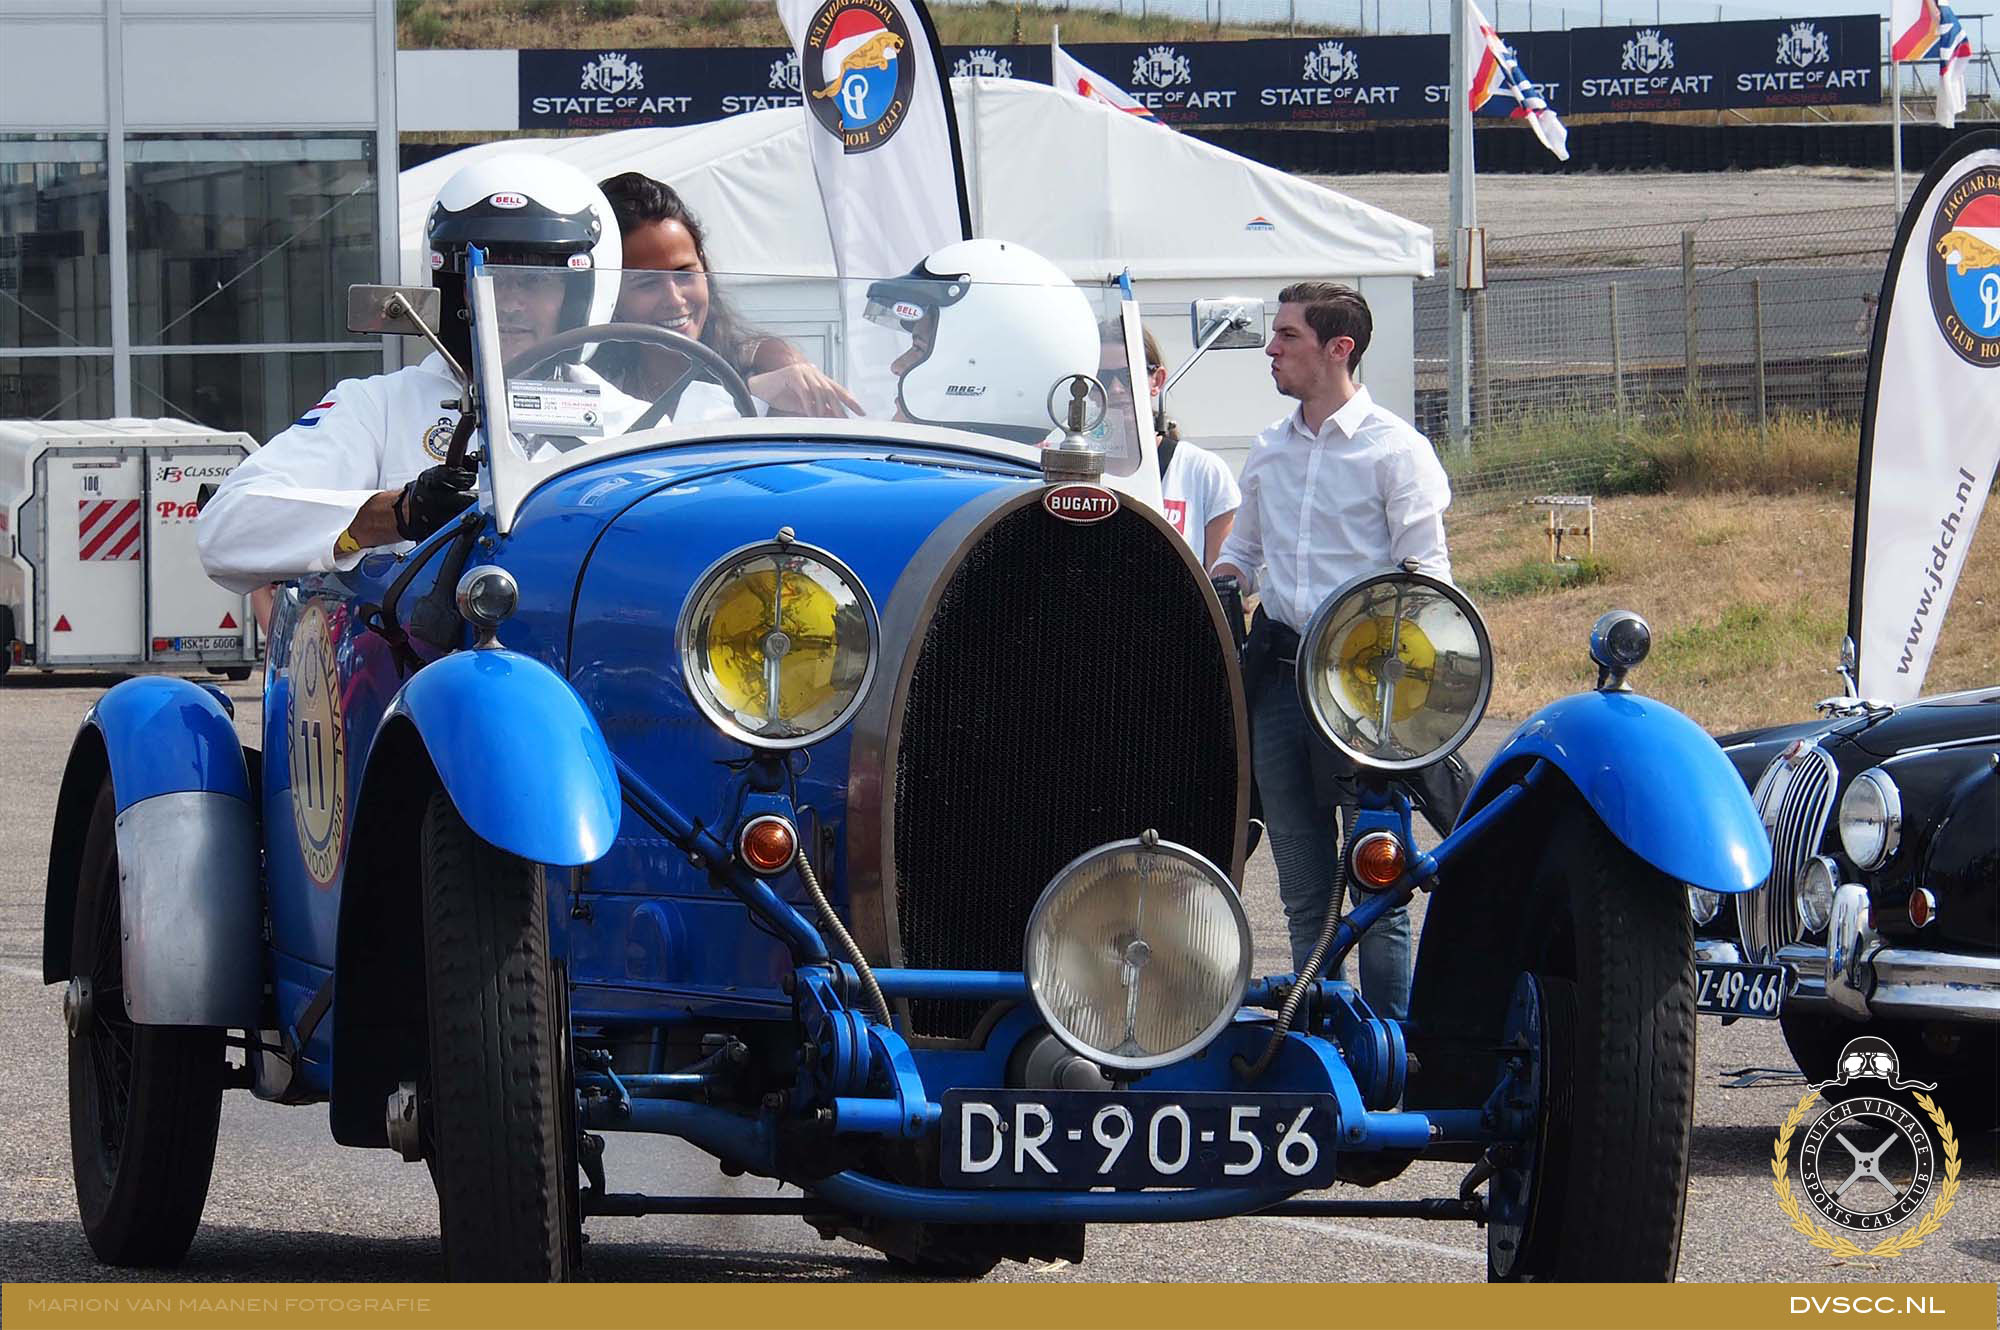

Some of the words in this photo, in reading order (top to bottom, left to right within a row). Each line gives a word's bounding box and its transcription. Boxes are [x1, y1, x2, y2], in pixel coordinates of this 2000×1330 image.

[1581, 78, 1649, 97] STATE
[1650, 77, 1669, 89] OF
[1669, 74, 1713, 94] ART
[1736, 72, 1805, 91] STATE
[1806, 71, 1825, 82] OF
[1825, 69, 1871, 88] ART
[532, 96, 614, 114] STATE
[615, 97, 638, 108] OF
[639, 96, 692, 114] ART
[721, 95, 802, 113] STATE
[1164, 91, 1185, 102] OF
[1186, 90, 1237, 108] ART
[1260, 88, 1332, 106] STATE
[1333, 87, 1353, 99] OF
[1353, 86, 1400, 104] ART
[495, 195, 522, 204] BELL
[1943, 175, 1985, 222] JAGUAR
[571, 258, 588, 267] BELL
[896, 304, 919, 317] BELL
[1945, 314, 1975, 352] CLUB
[84, 476, 98, 491] 100
[163, 466, 183, 483] F3
[1051, 495, 1112, 512] BUGATTI
[1897, 467, 1976, 674] www.jdch.nl
[301, 720, 325, 810] 11
[1696, 969, 1778, 1012] Z-49-66
[960, 1102, 1319, 1175] DR-90-56
